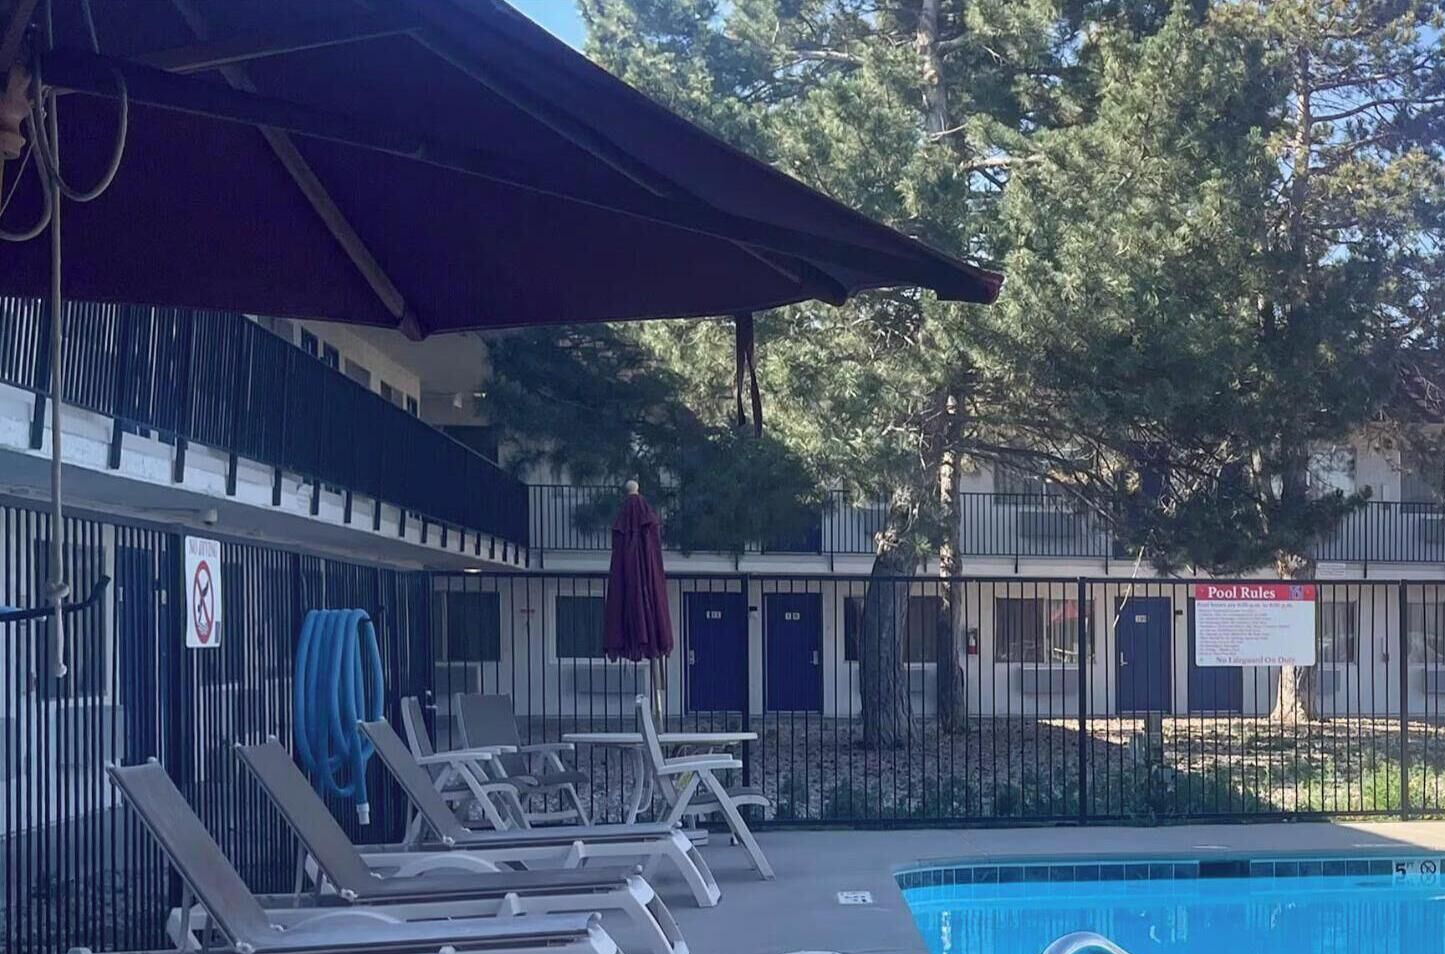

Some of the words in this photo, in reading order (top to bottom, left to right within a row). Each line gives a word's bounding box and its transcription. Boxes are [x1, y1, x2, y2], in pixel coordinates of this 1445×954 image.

[1208, 586, 1237, 599] Pool
[1241, 586, 1276, 599] Rules
[1396, 863, 1406, 875] 5
